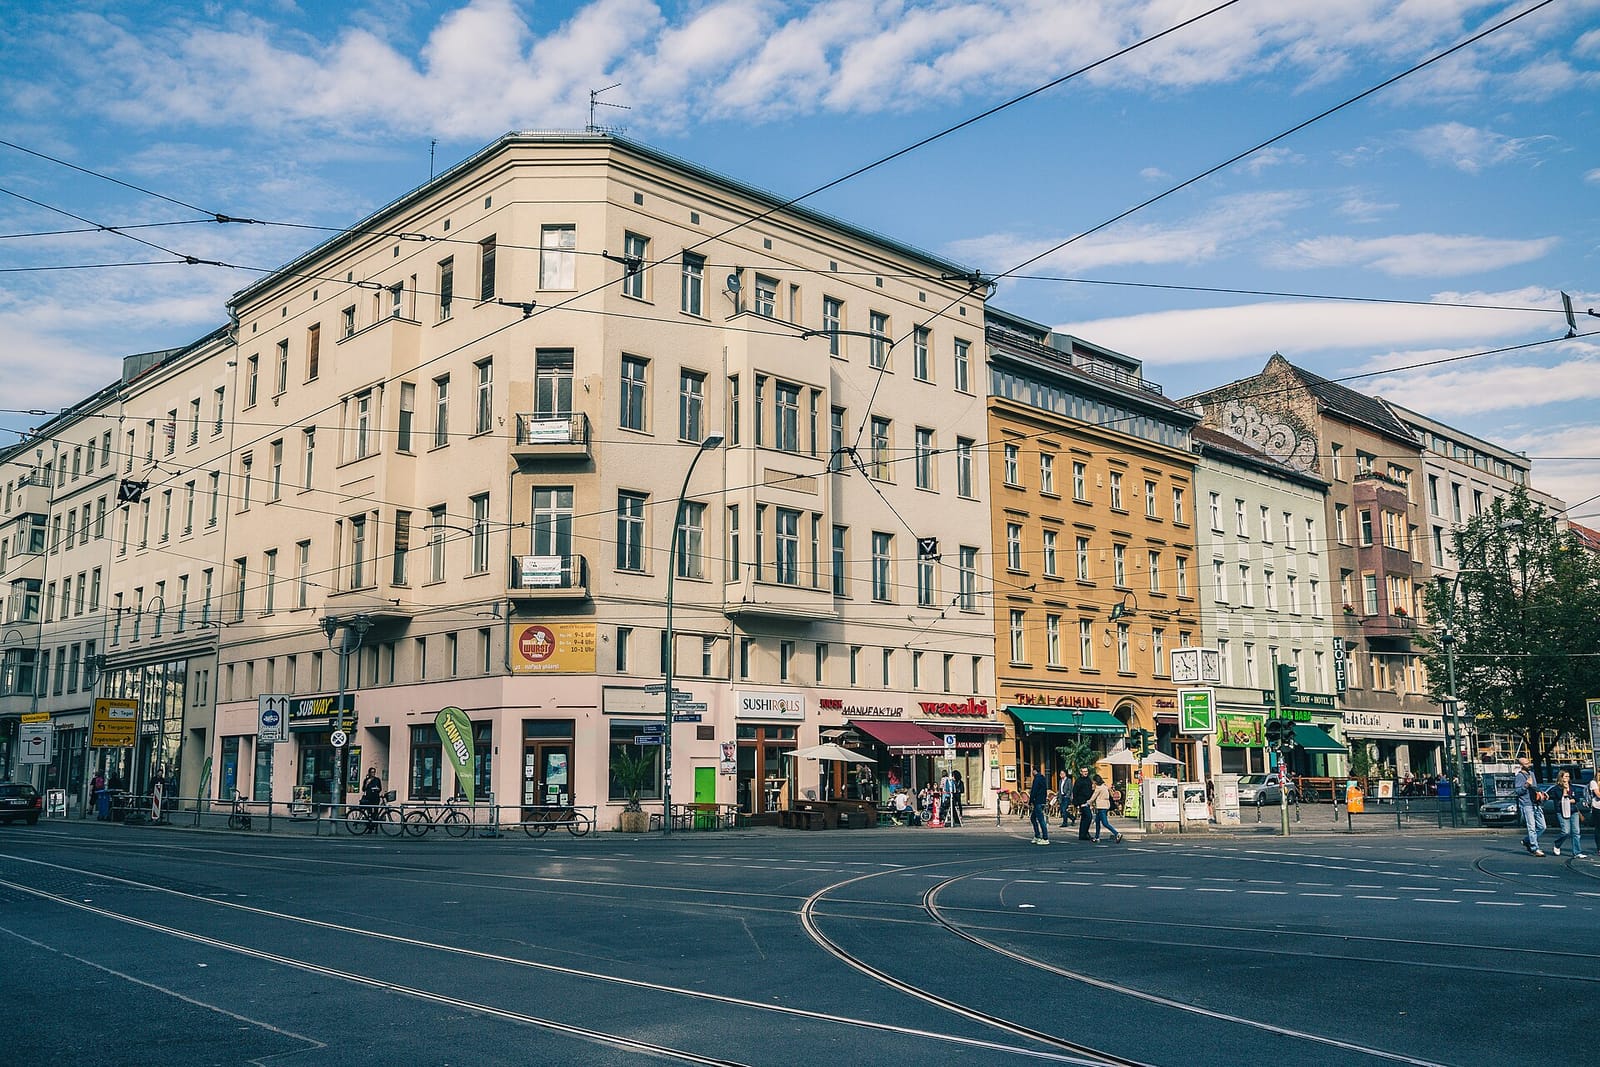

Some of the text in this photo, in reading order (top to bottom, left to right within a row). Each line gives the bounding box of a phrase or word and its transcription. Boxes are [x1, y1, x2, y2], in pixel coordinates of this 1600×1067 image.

[523, 644, 550, 653] WURST
[1333, 639, 1345, 691] HOTEL
[1014, 693, 1101, 709] THAI CUISINE
[1314, 696, 1330, 704] HOTEL
[296, 697, 333, 717] SUBWAY
[842, 706, 904, 717] MANUFAKTUR
[917, 696, 988, 716] wasabi
[1294, 710, 1313, 721] BABA
[1402, 718, 1415, 729] CAFE
